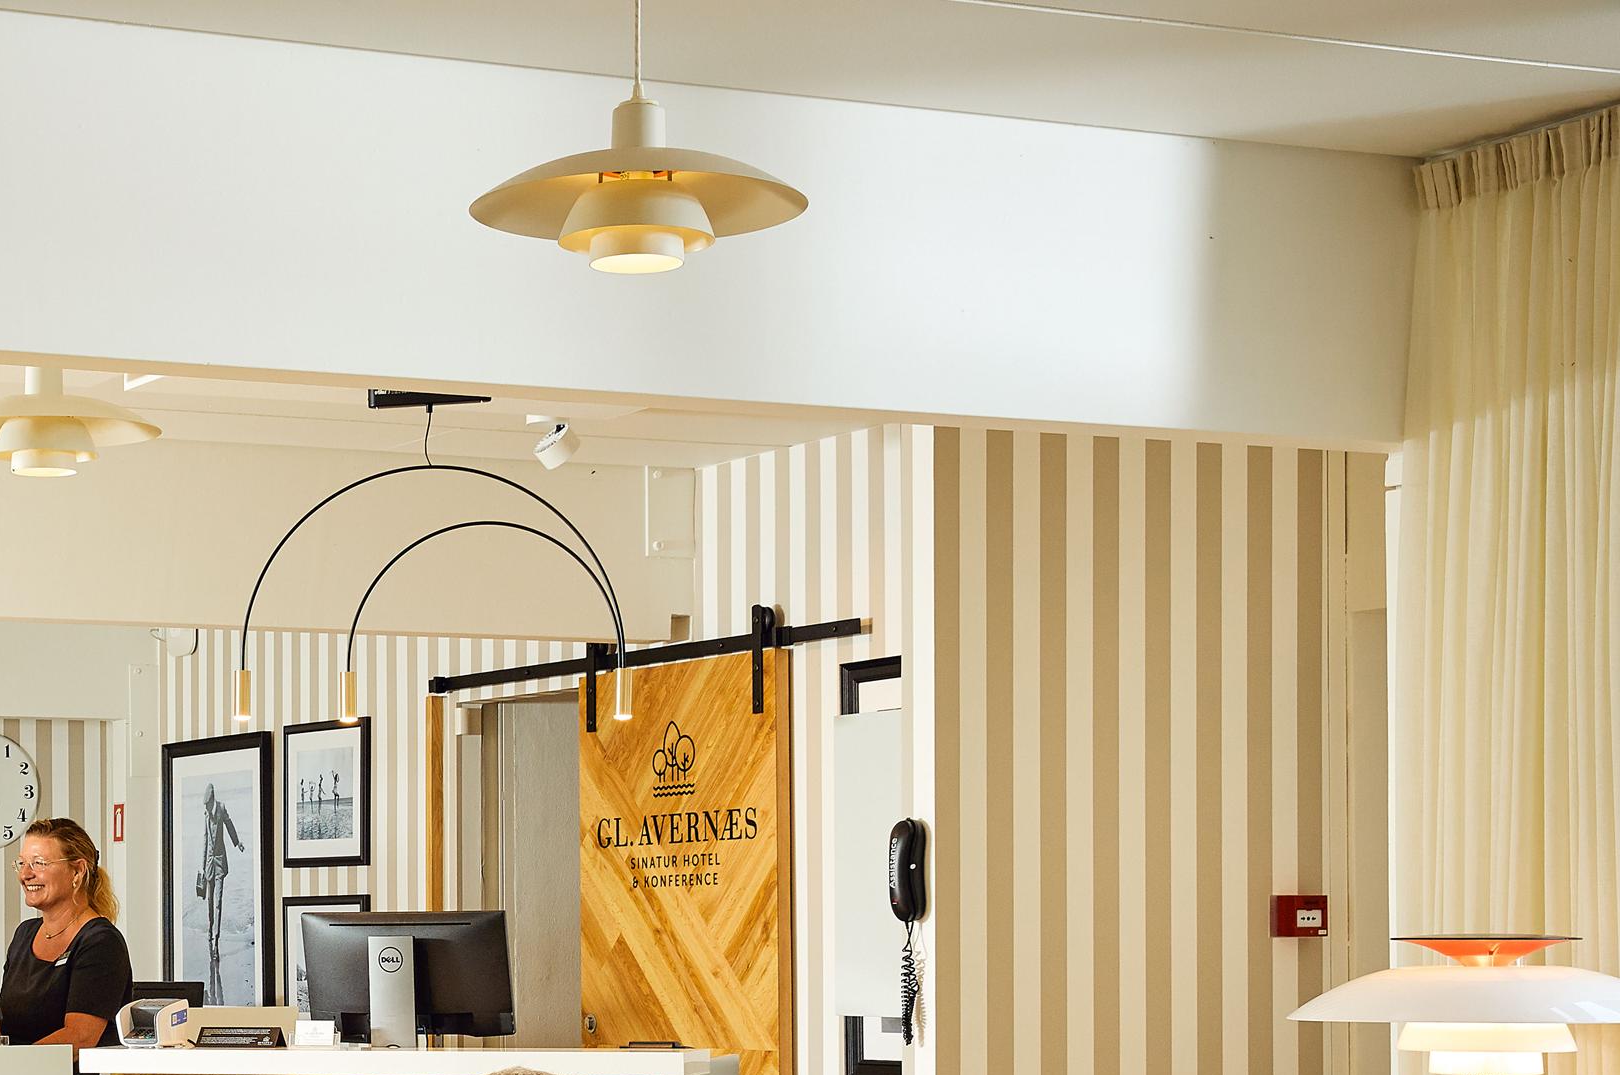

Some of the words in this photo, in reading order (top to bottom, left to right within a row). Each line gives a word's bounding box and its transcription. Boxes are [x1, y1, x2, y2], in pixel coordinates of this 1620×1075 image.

[5, 744, 10, 758] 1
[20, 762, 29, 775] 2
[24, 785, 34, 799] 3
[17, 808, 27, 822] 4
[3, 825, 13, 839] 5
[597, 818, 634, 848] GL.
[638, 807, 758, 846] AVERNÆS
[630, 855, 678, 869] SINATUR
[683, 853, 720, 867] HOTEL
[889, 837, 898, 889] Assistance
[632, 877, 639, 888] &
[644, 873, 719, 888] KONFERENCE
